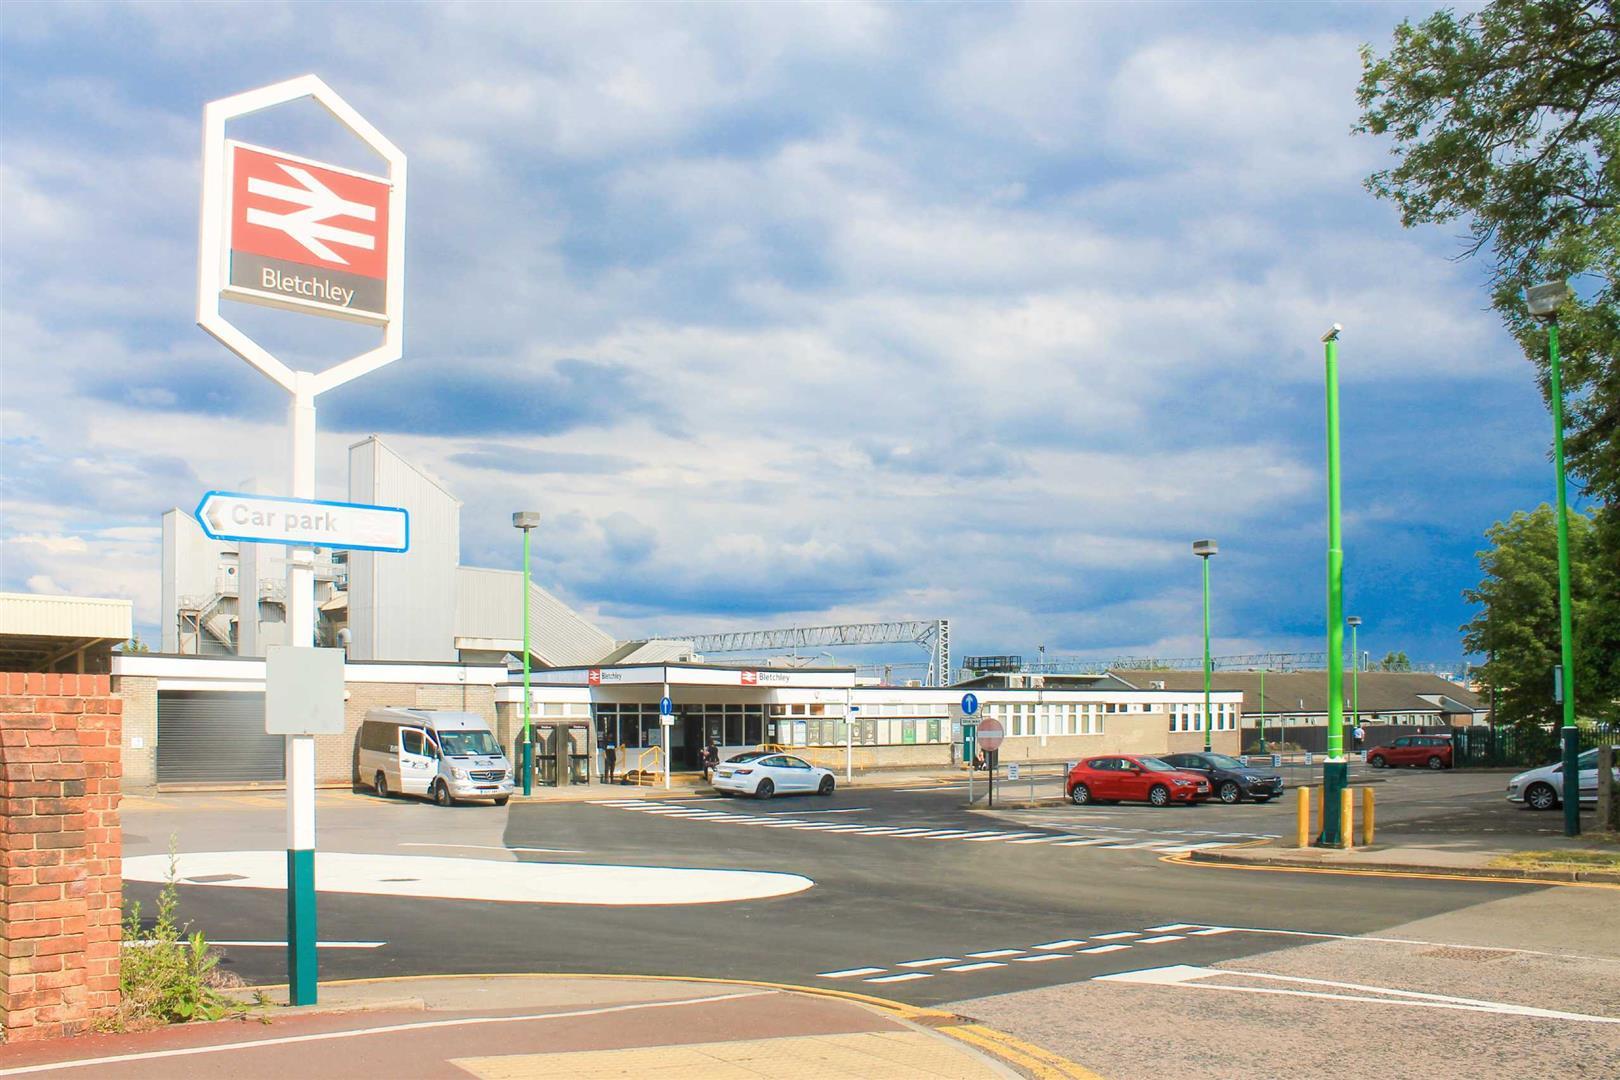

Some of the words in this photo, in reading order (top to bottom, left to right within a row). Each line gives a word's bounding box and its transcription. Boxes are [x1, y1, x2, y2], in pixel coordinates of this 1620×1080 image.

[261, 267, 354, 306] Bletchley
[231, 503, 275, 527] Car
[284, 511, 338, 532] park
[601, 672, 622, 681] Bletchley
[759, 672, 790, 683] Bletchley
